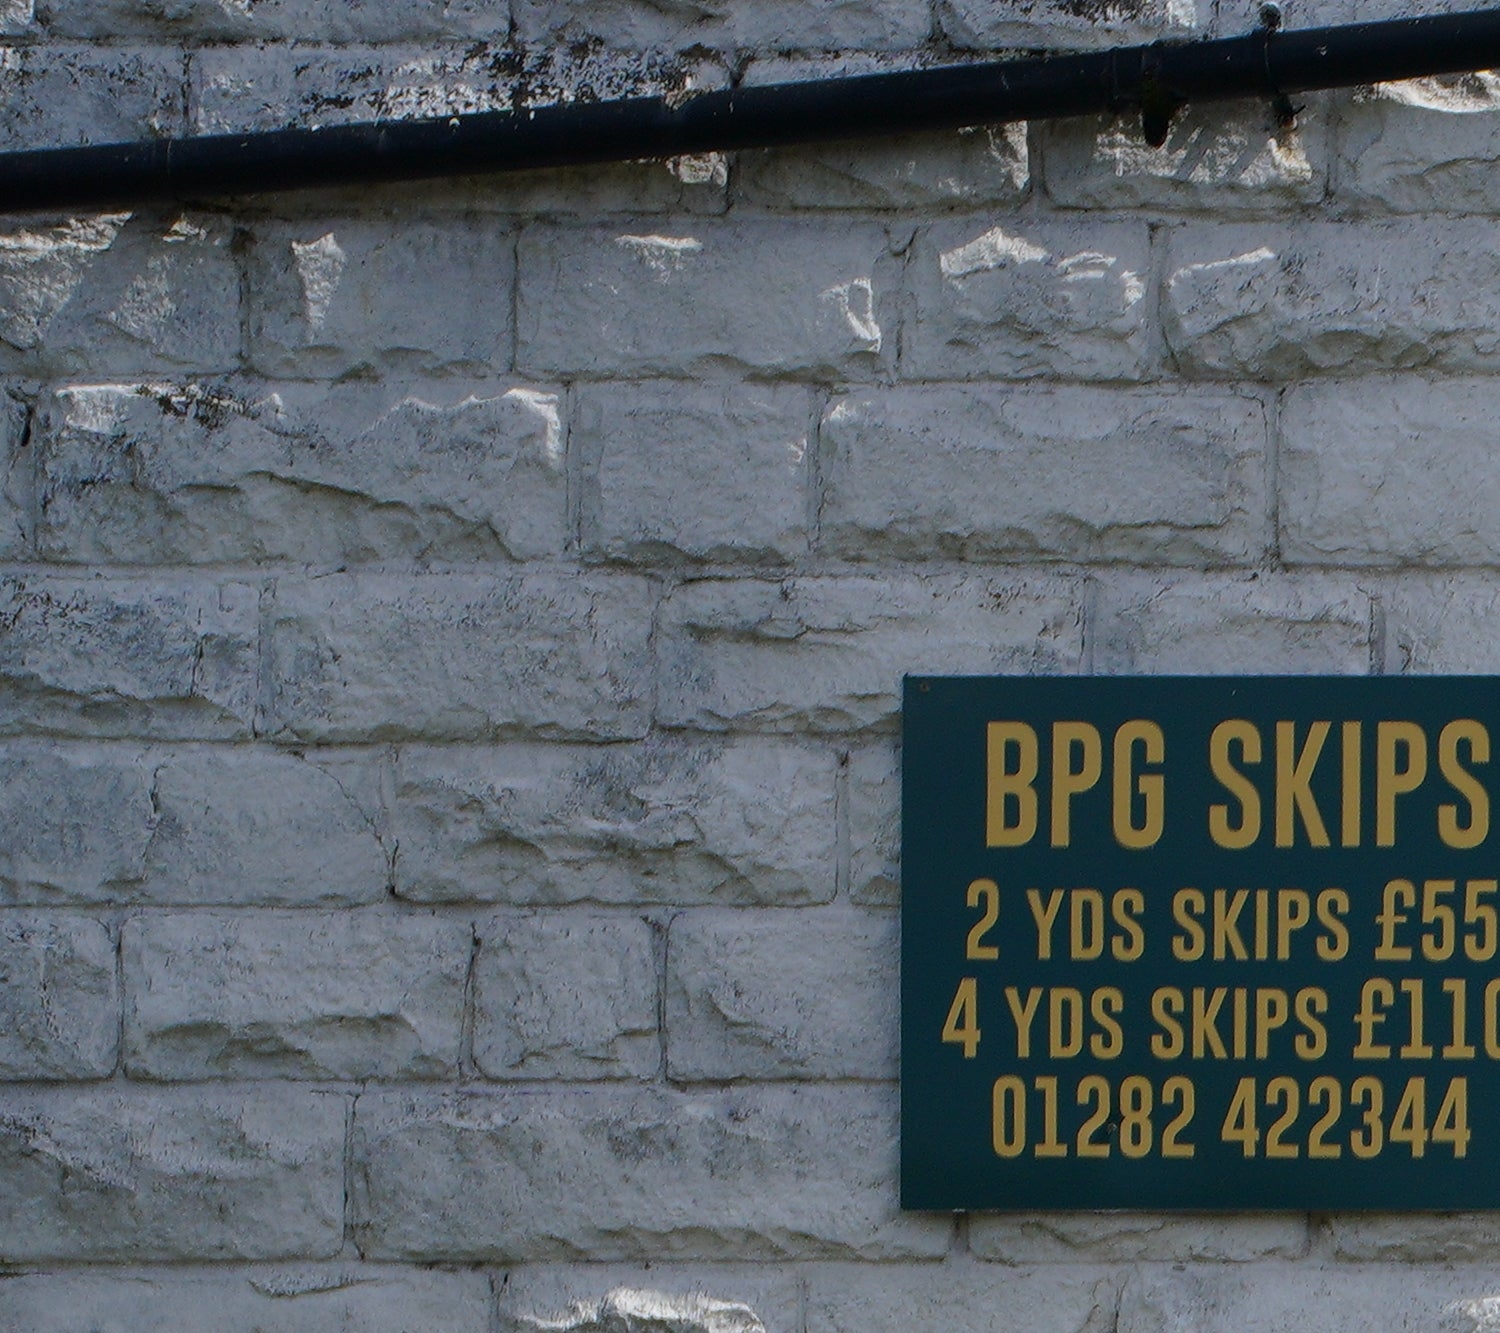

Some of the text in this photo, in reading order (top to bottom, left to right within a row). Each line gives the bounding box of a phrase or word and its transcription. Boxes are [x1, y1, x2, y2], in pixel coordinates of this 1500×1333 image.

[987, 719, 1490, 849] BPG SKIPS
[966, 878, 1498, 961] 2 YDS SKIPS £55
[942, 978, 981, 1059] 4
[1005, 986, 1124, 1059] YDS
[1151, 986, 1329, 1060] SKIPS
[992, 1075, 1471, 1158] 01282 422344
